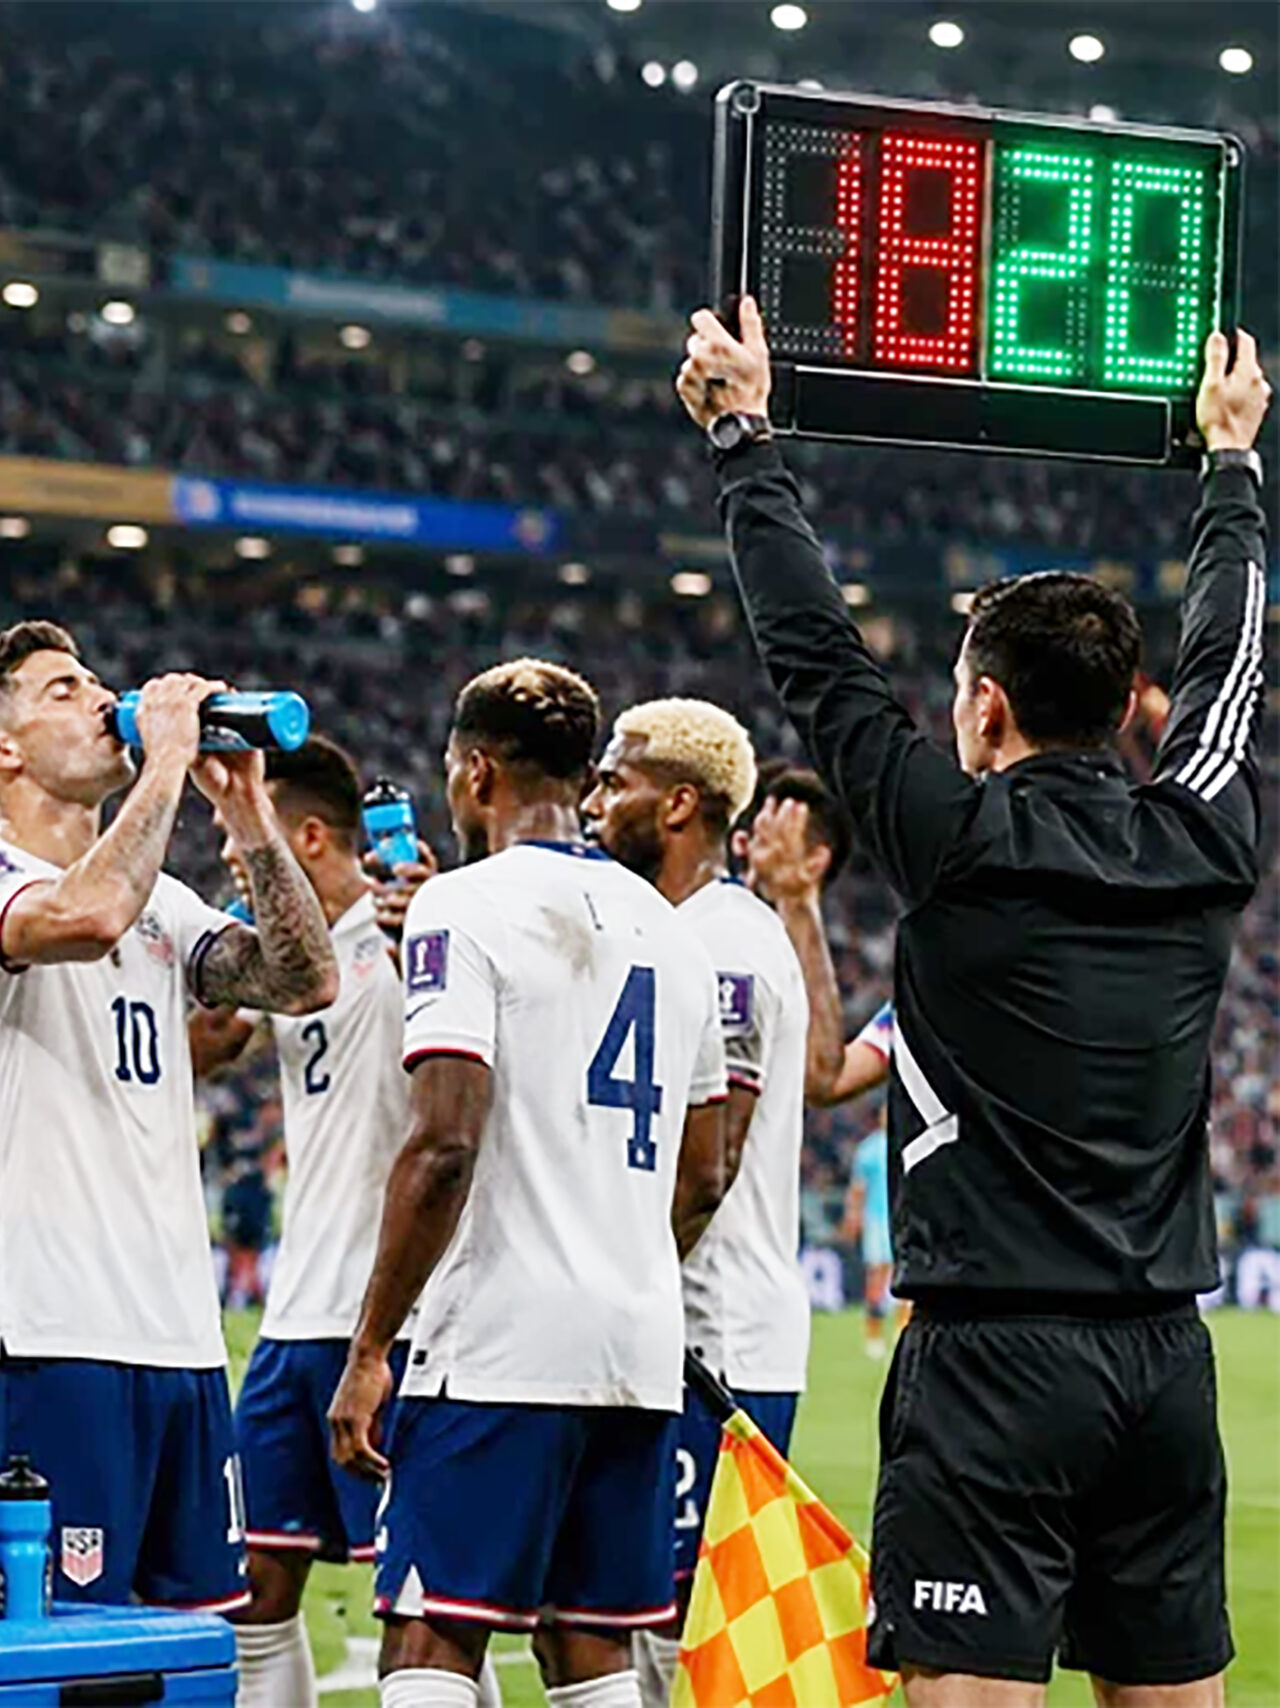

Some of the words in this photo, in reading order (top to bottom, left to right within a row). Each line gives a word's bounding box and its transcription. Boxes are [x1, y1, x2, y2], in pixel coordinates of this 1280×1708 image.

[834, 132, 978, 367] 18
[993, 149, 1204, 387] 20
[111, 995, 161, 1085] 10
[301, 1018, 331, 1095] 2
[587, 964, 663, 1172] 4
[913, 1578, 988, 1616] FIFA
